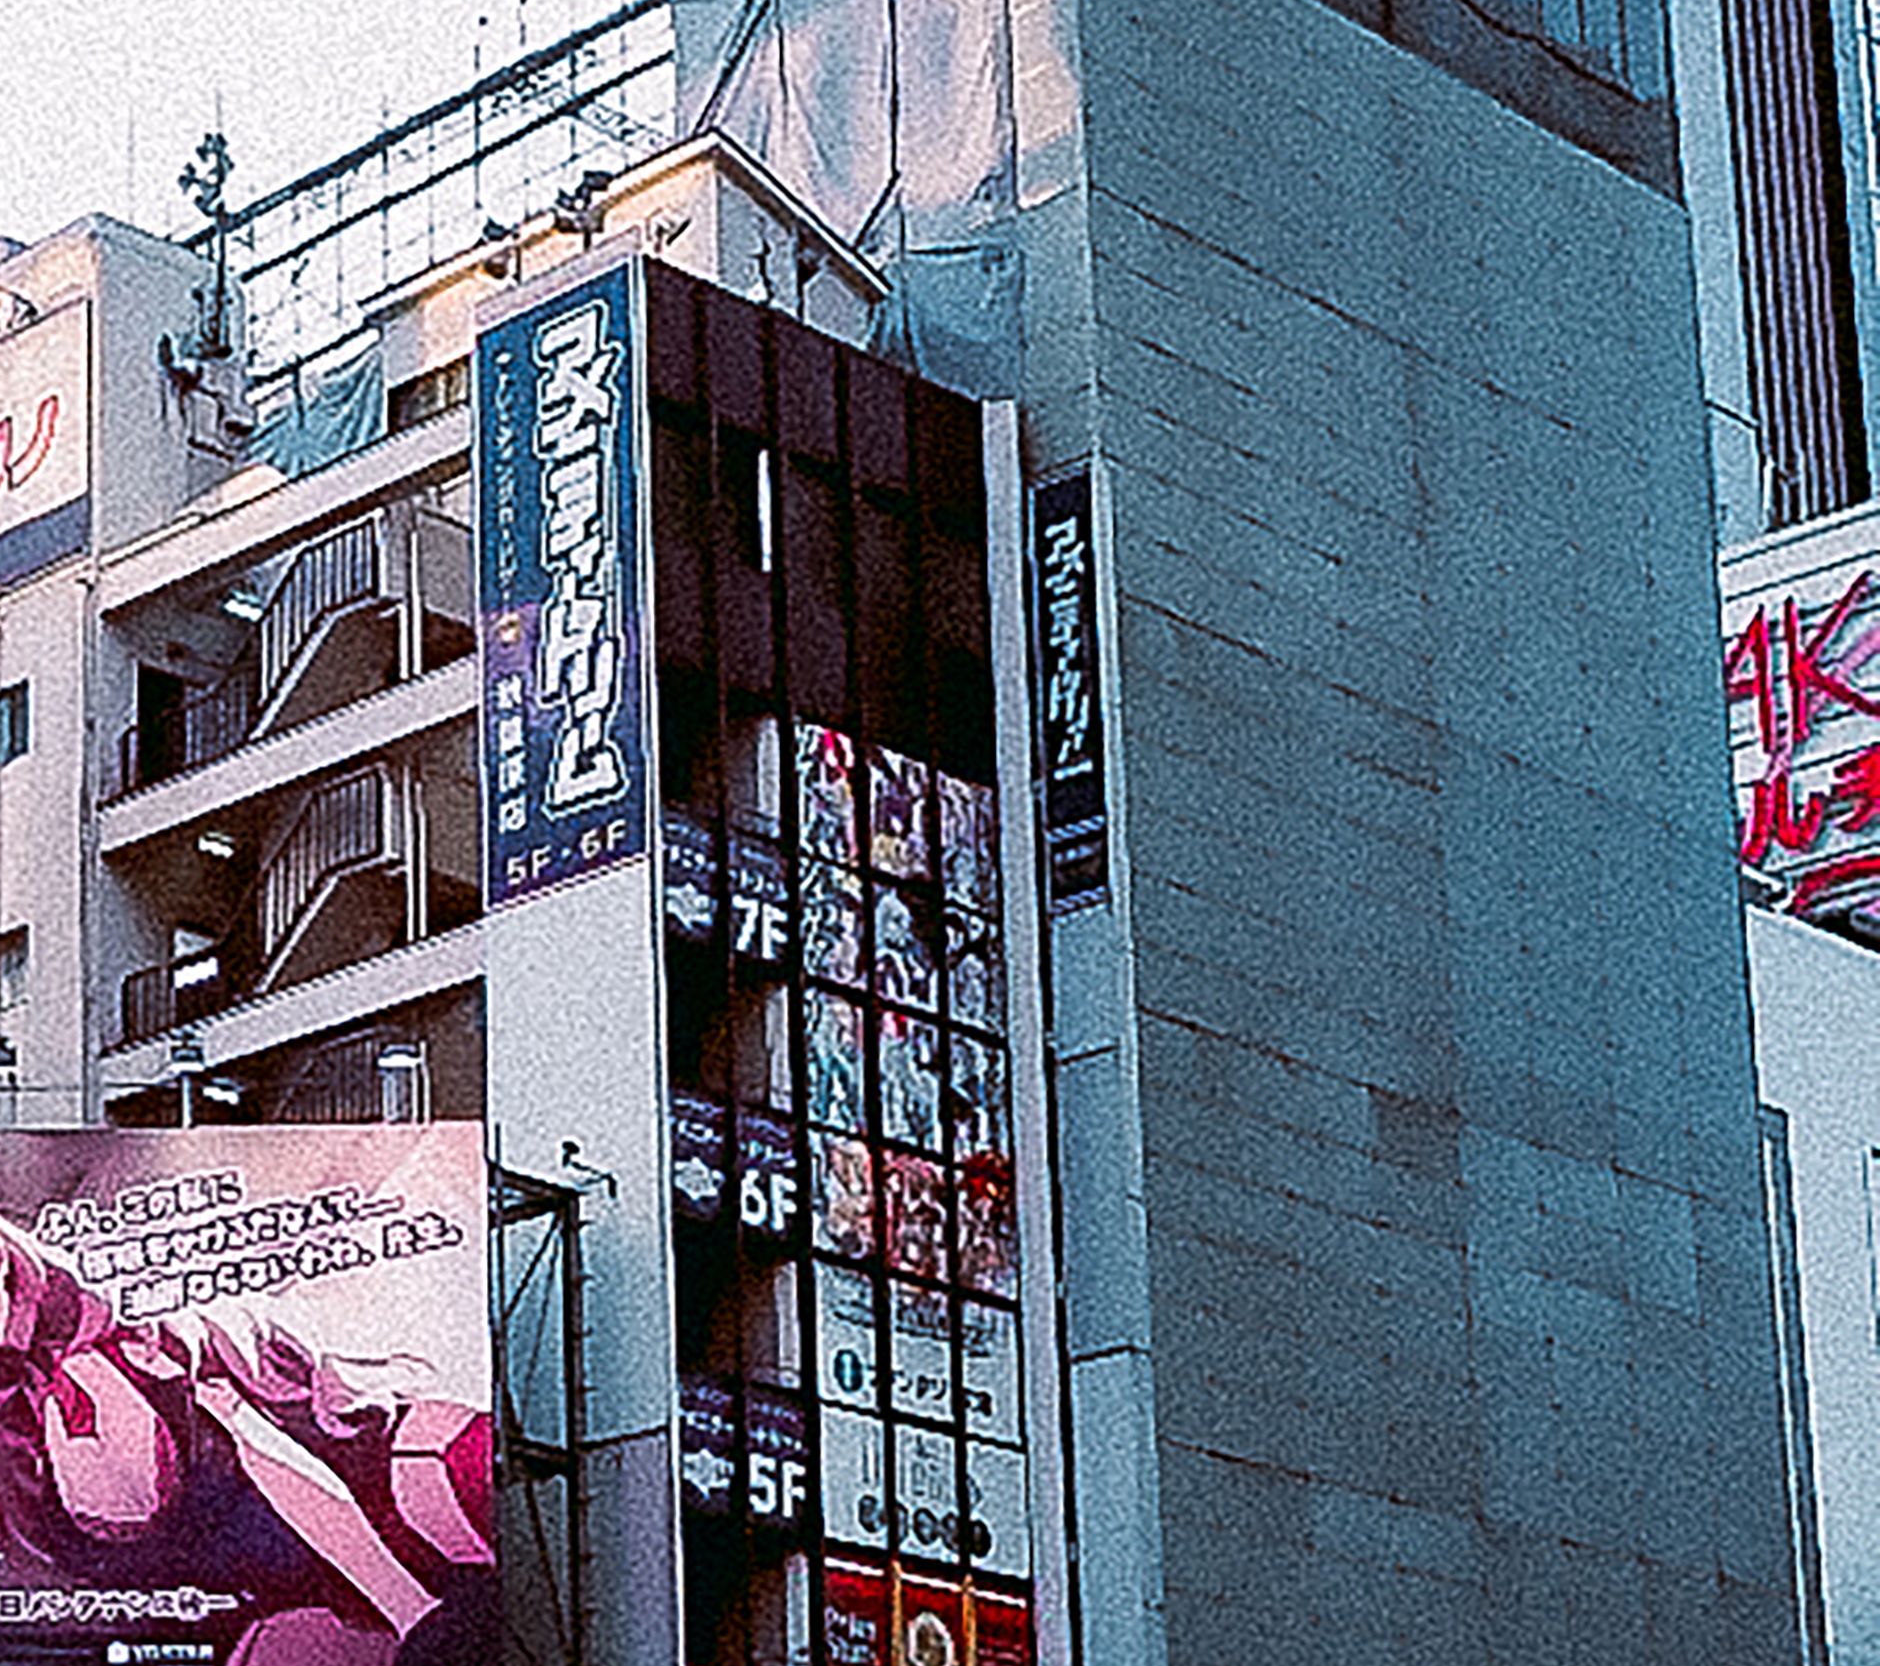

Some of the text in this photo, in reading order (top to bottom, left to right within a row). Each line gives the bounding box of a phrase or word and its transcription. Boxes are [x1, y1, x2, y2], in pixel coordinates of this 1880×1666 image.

[732, 896, 788, 962] 7F
[740, 1168, 797, 1234] 6F
[748, 1452, 807, 1520] 5F
